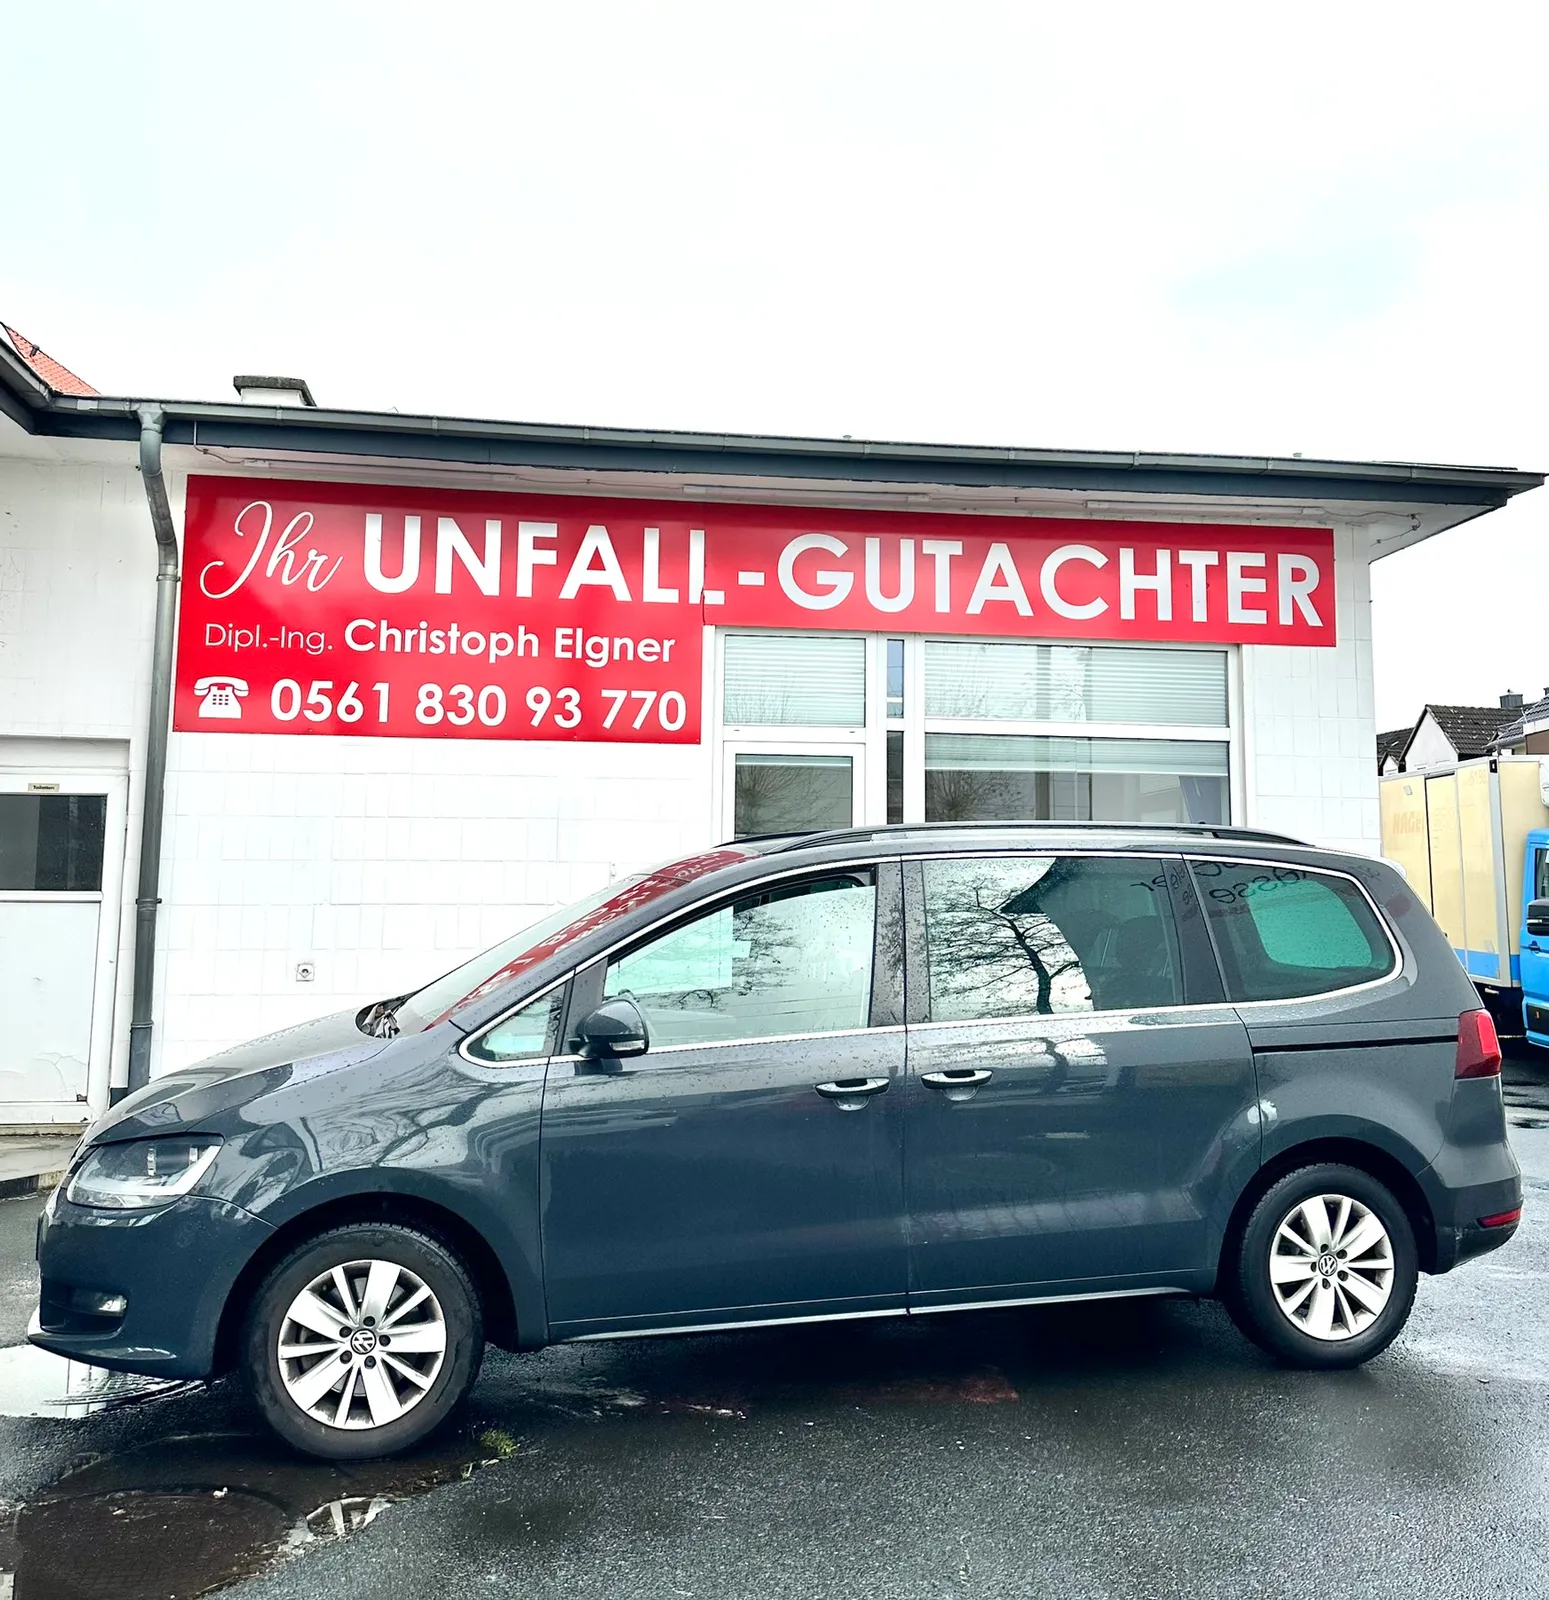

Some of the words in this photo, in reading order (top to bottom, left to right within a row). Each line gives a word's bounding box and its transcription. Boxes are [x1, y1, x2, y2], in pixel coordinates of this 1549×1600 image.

[199, 500, 343, 599] Ihr
[205, 623, 333, 655] Dipl.-Ing.
[344, 618, 539, 664] Christoph
[554, 627, 676, 668] Elgner
[270, 678, 390, 723] 0561
[415, 683, 507, 727] 830
[525, 686, 582, 729] 93
[601, 689, 687, 732] 770
